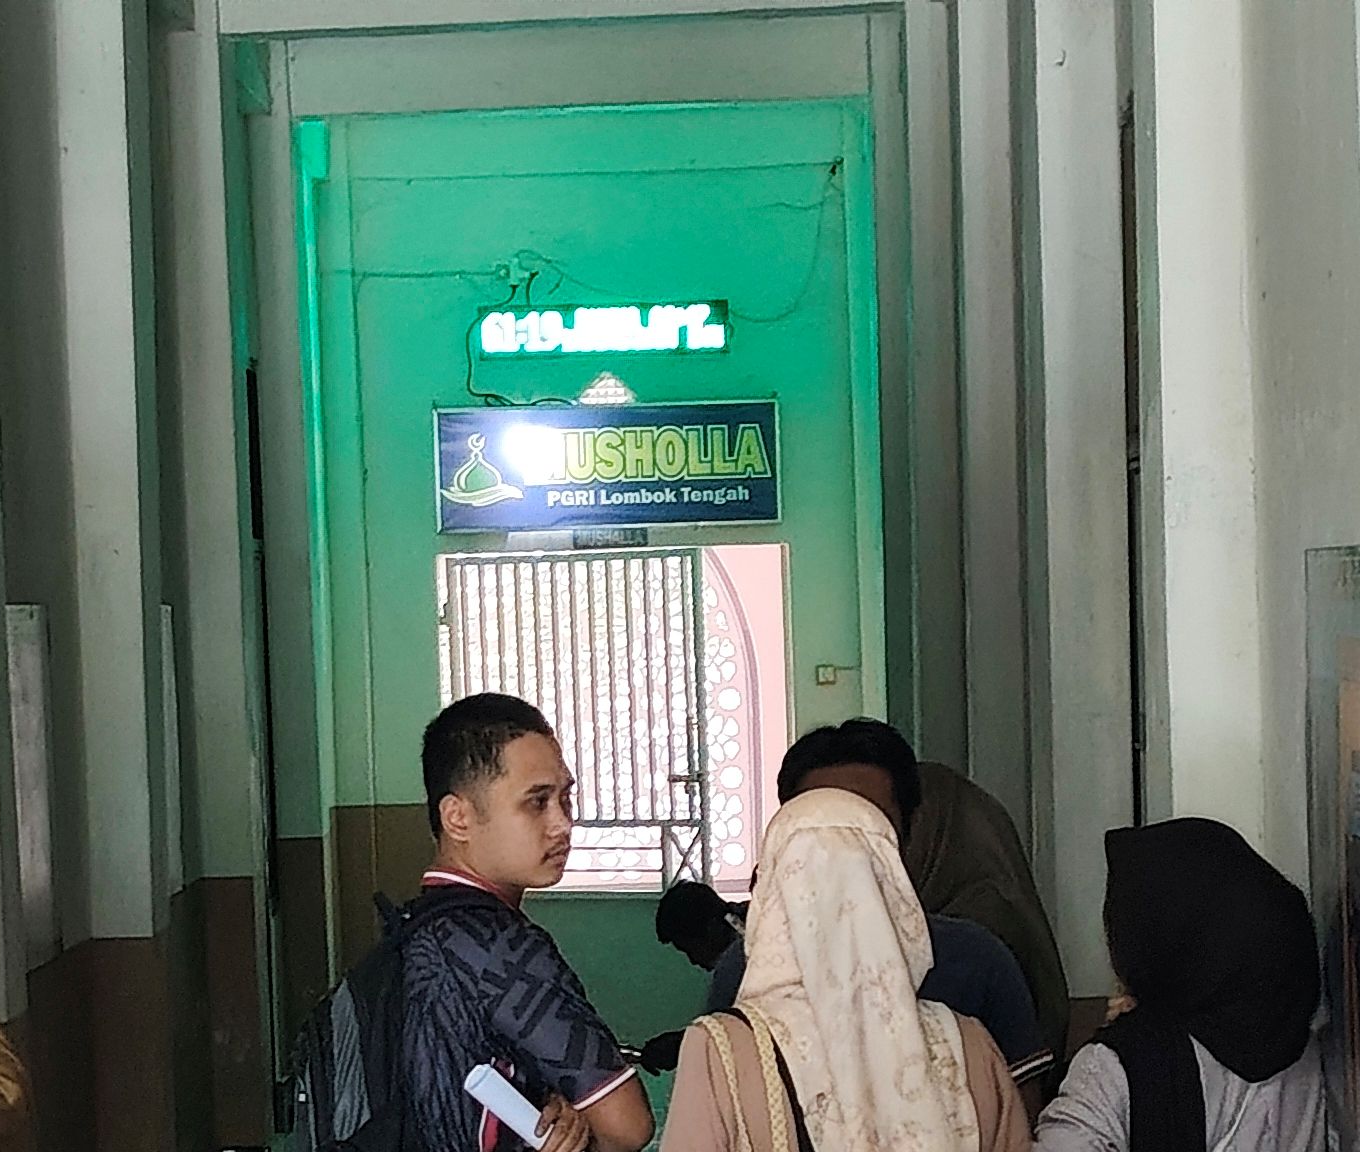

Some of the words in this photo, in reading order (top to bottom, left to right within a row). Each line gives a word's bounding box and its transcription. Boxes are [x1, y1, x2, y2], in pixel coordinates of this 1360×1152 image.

[523, 424, 771, 486] USHOLLA
[547, 490, 596, 507] PGRI
[600, 488, 678, 506] Lombok
[680, 485, 750, 504] Tengah
